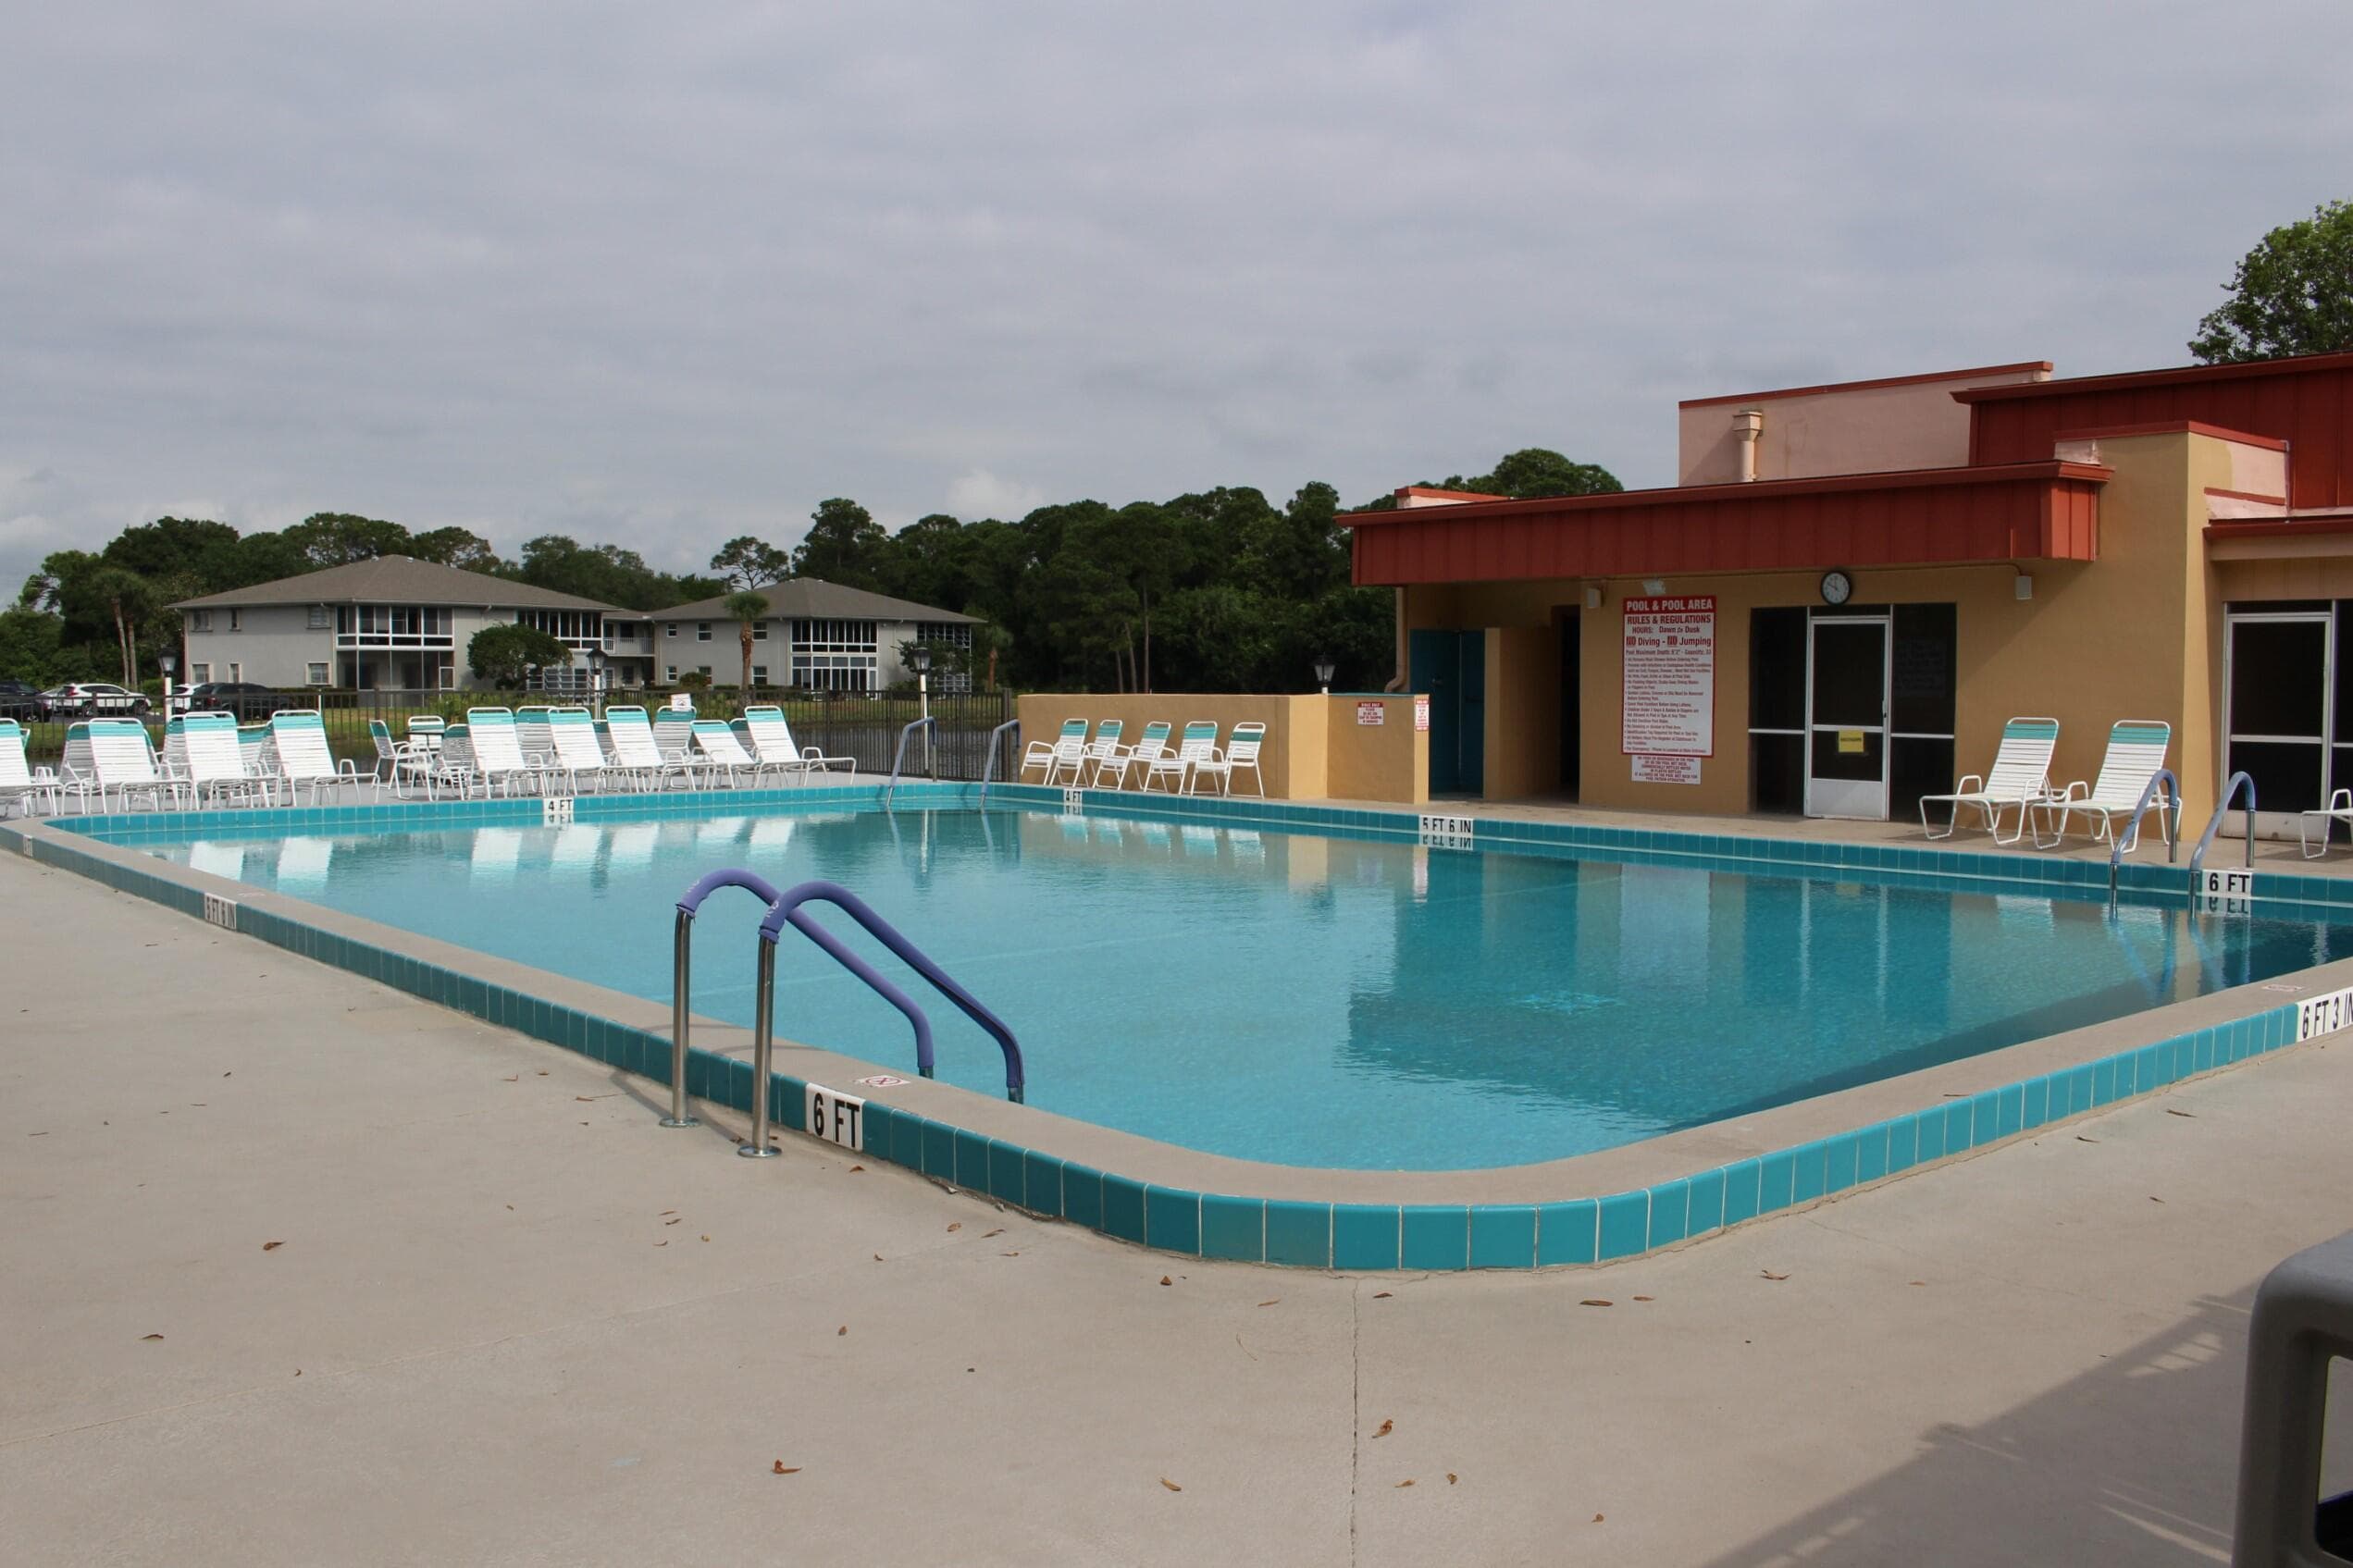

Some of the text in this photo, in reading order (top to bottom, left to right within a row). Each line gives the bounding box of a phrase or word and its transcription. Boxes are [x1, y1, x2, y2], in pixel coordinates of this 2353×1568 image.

[1627, 599, 1713, 611] POOL & POOL AREA
[1628, 614, 1711, 624] RULES & REGULATIONS
[1626, 636, 1637, 646] NO
[1638, 637, 1660, 648] Diving
[1667, 636, 1678, 646] NO
[1679, 636, 1712, 648] Jumping
[1073, 791, 1081, 802] FT
[548, 799, 572, 811] 4 FT
[1423, 818, 1471, 833] 5 FT 6 IN
[2210, 872, 2250, 893] 6 FT
[2302, 1005, 2310, 1039] 6
[2314, 1000, 2329, 1035] FT
[2333, 996, 2339, 1030] 3
[814, 1093, 860, 1147] 6 FT
